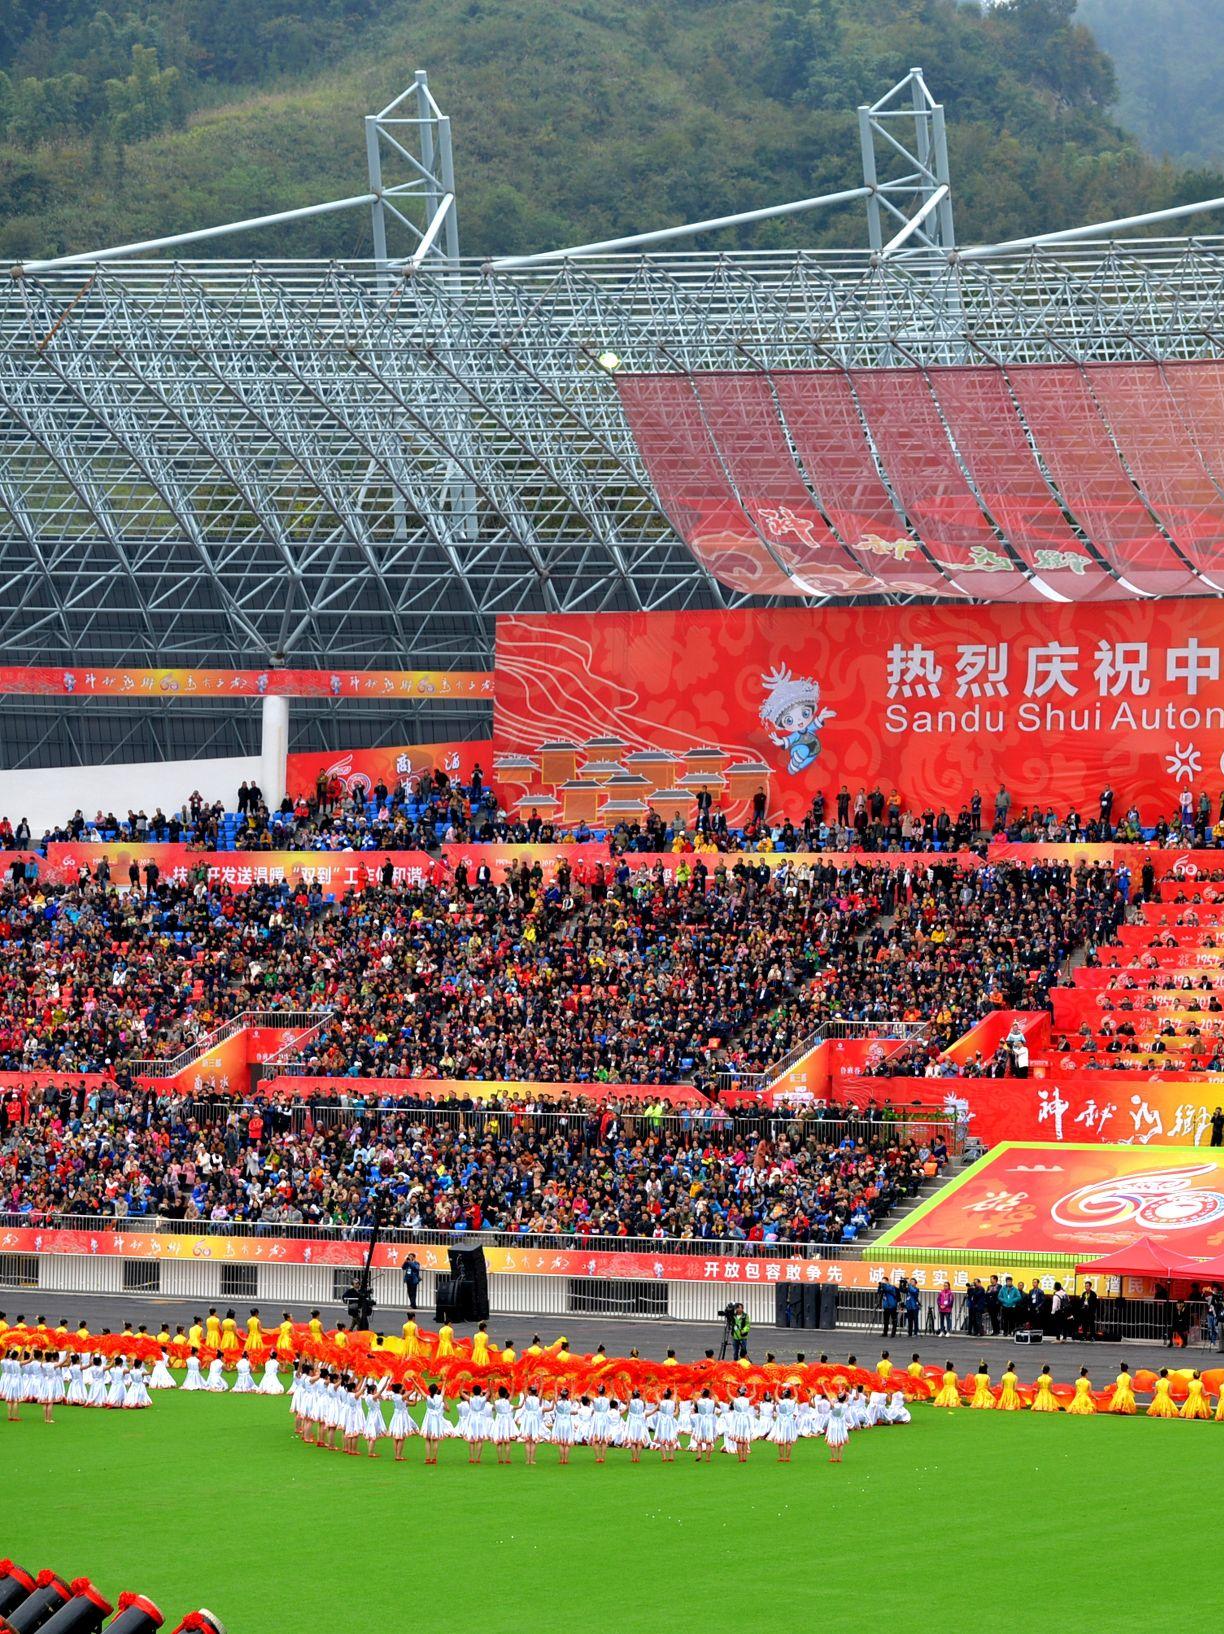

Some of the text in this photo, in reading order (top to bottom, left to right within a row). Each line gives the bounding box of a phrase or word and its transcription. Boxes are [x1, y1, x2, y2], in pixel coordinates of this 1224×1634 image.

[885, 703, 1005, 733] Sandu
[1017, 701, 1101, 731] Shui
[1196, 955, 1219, 963] 1957
